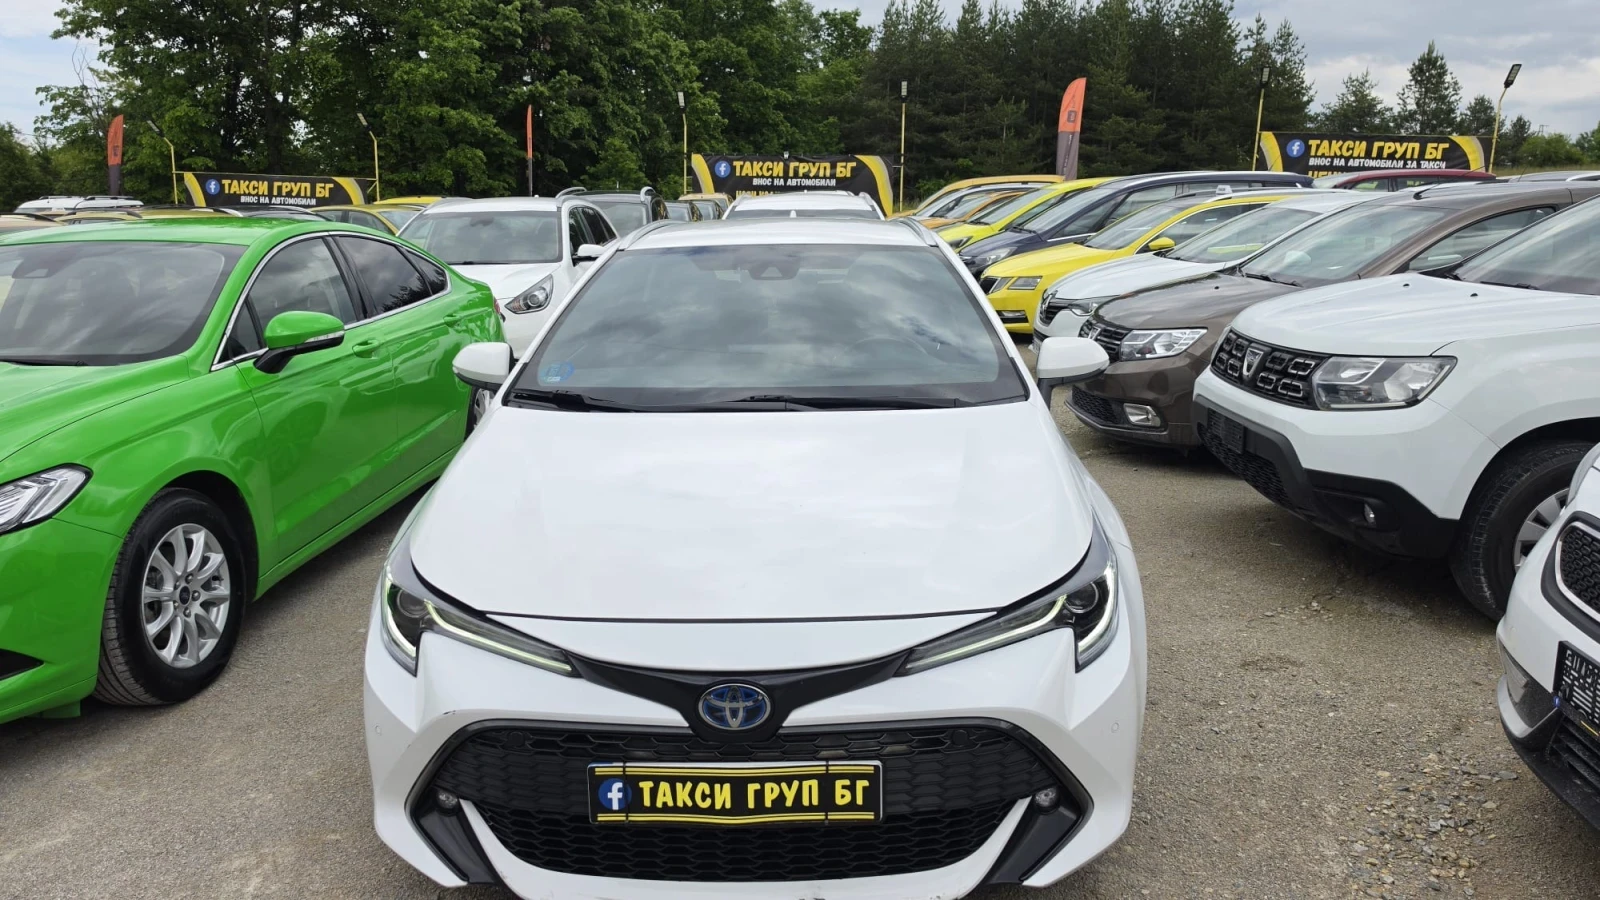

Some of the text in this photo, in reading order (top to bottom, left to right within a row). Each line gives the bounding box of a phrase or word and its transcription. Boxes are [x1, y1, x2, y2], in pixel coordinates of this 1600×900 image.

[1308, 139, 1366, 157] ТАКСИ
[1371, 141, 1420, 159] ГРУП
[1424, 143, 1449, 160] БГ
[733, 161, 784, 177] ТАКСИ
[788, 161, 831, 178] ГРУП
[835, 162, 857, 178] БГ
[1308, 157, 1446, 170] ВНОС НА АВТОМОБИЛИ ЗА ТАКСИ
[221, 179, 269, 196] ТАКСИ
[273, 181, 311, 197] ГРУП
[315, 183, 334, 198] БГ
[752, 178, 836, 187] ВНОС НА АВТОМОБИЛИ
[240, 195, 317, 206] ВНОС НА АВТОМОБИЛИ
[639, 781, 732, 810] ТАКСИ
[747, 779, 819, 809] ГРУП
[835, 779, 869, 806] БГ
